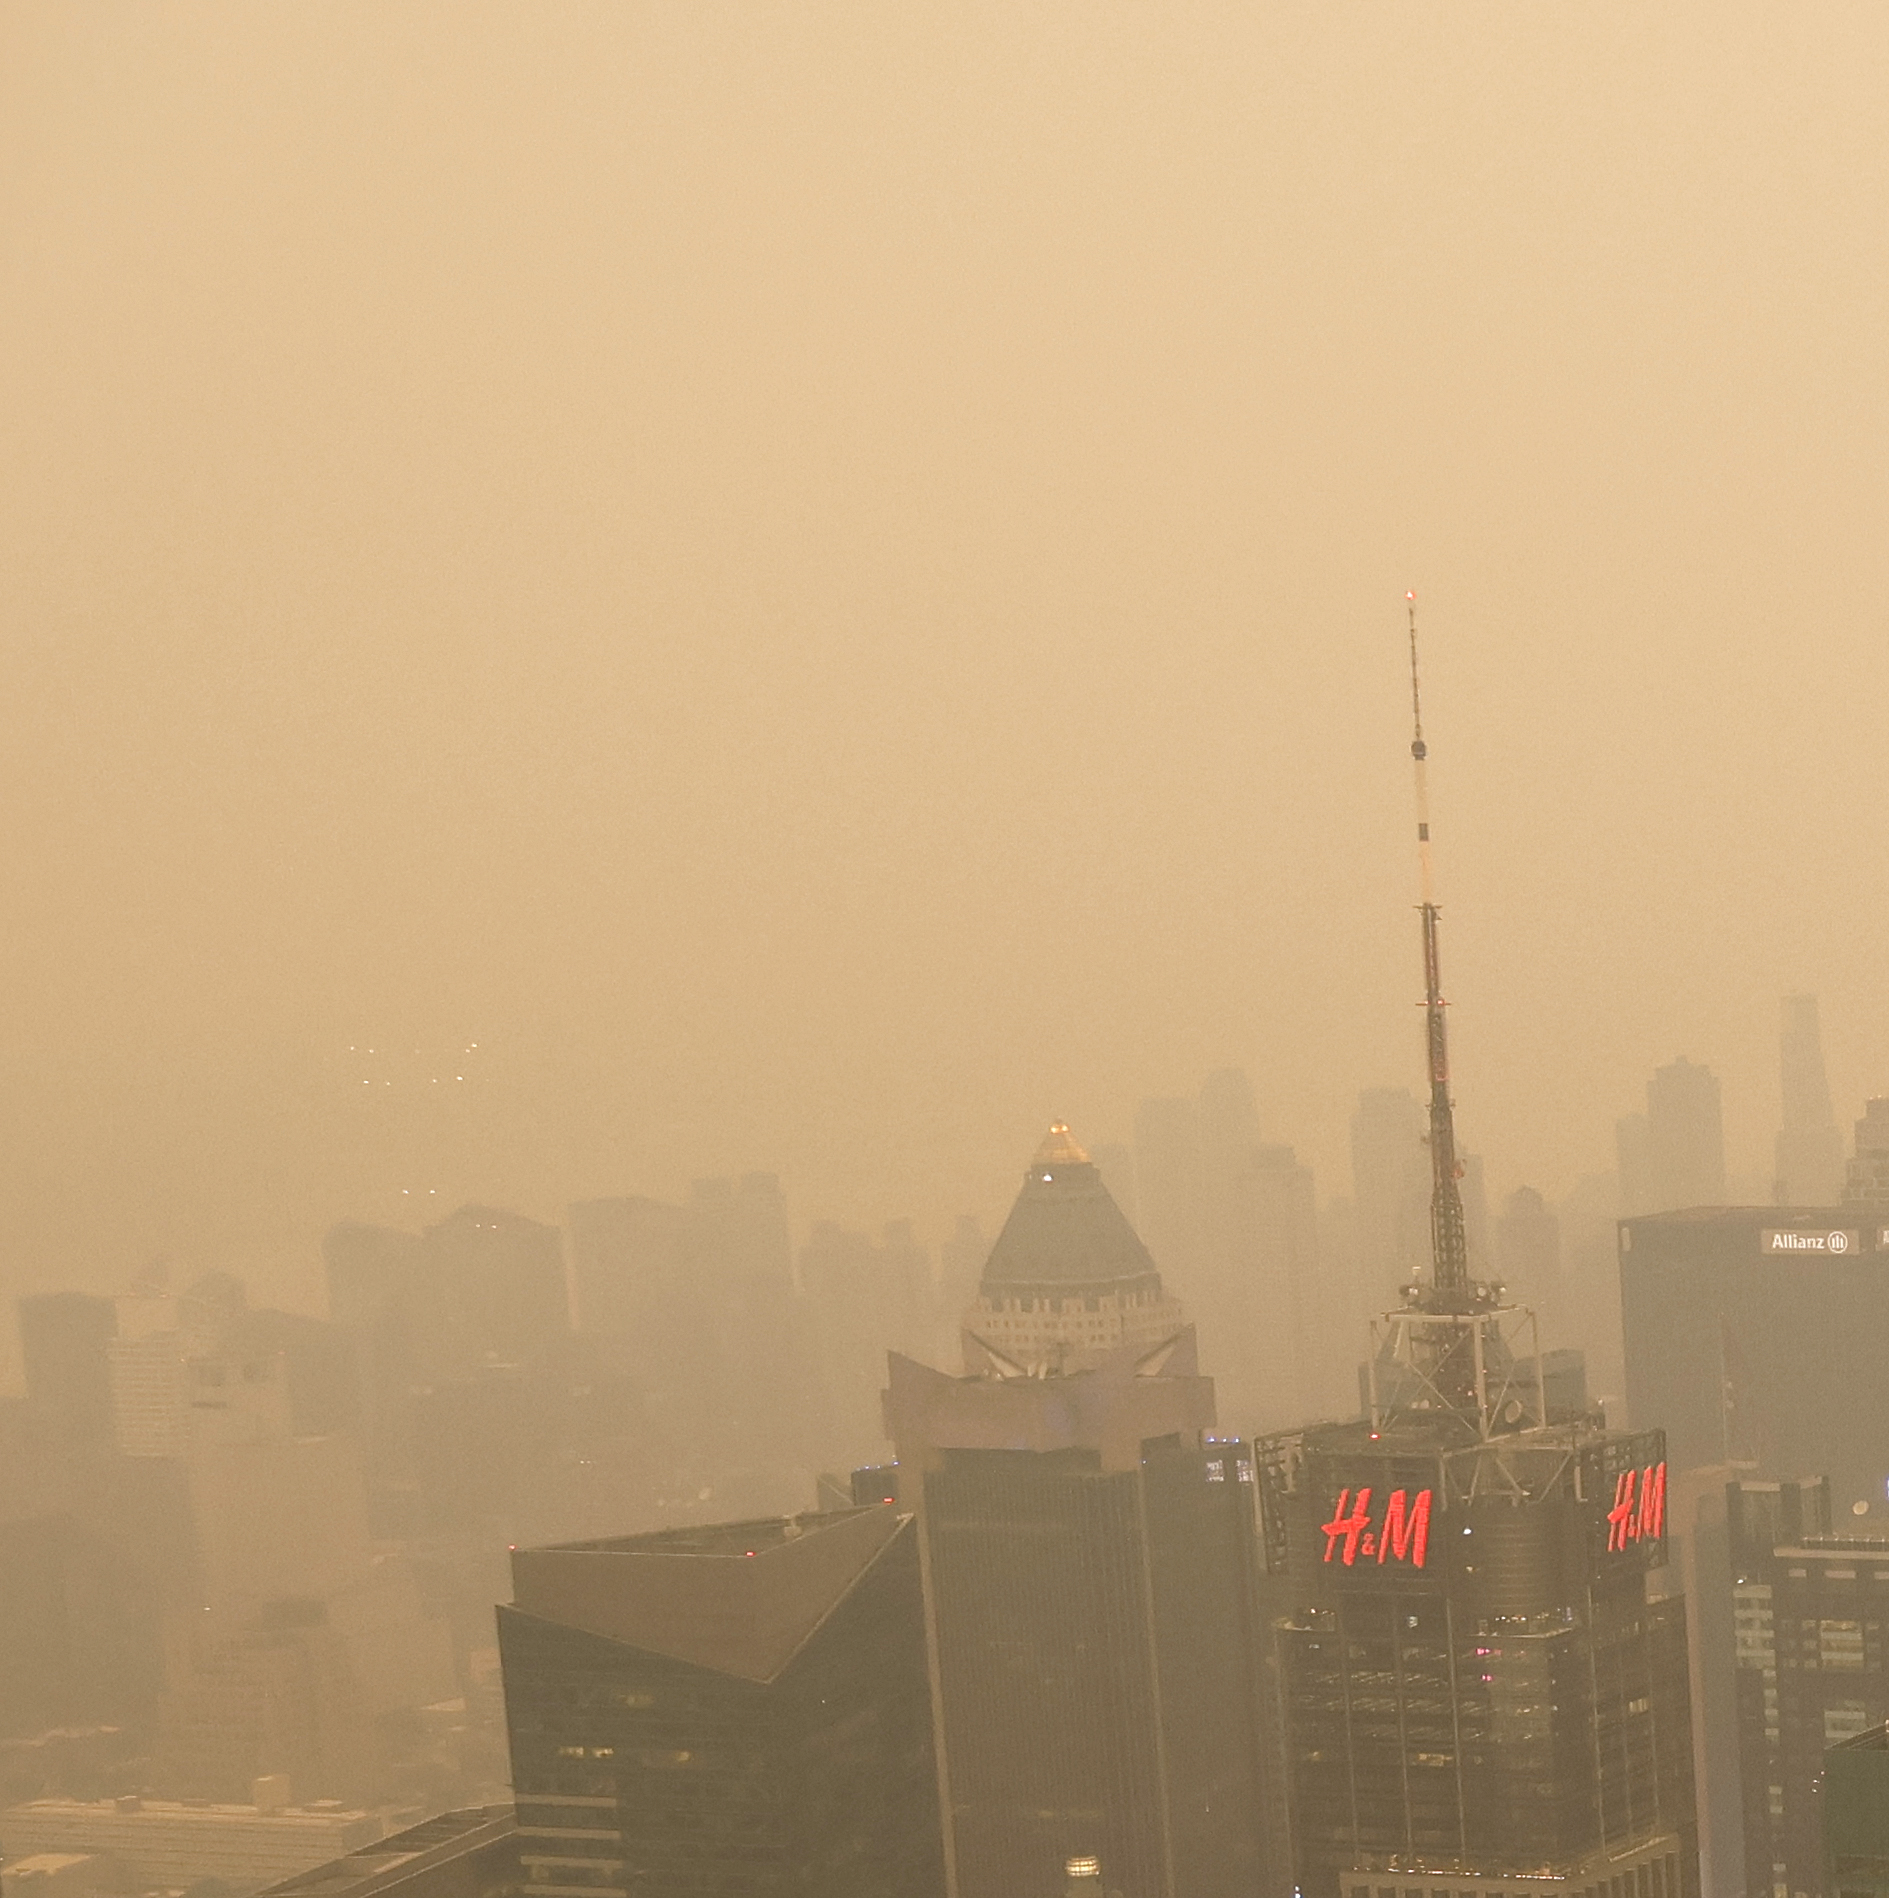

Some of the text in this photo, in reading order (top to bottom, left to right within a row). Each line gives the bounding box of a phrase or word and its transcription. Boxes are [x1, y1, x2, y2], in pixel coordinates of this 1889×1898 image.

[1772, 1233, 1825, 1249] Allianz
[1321, 1488, 1432, 1567] H&M
[1607, 1462, 1667, 1551] H&M
